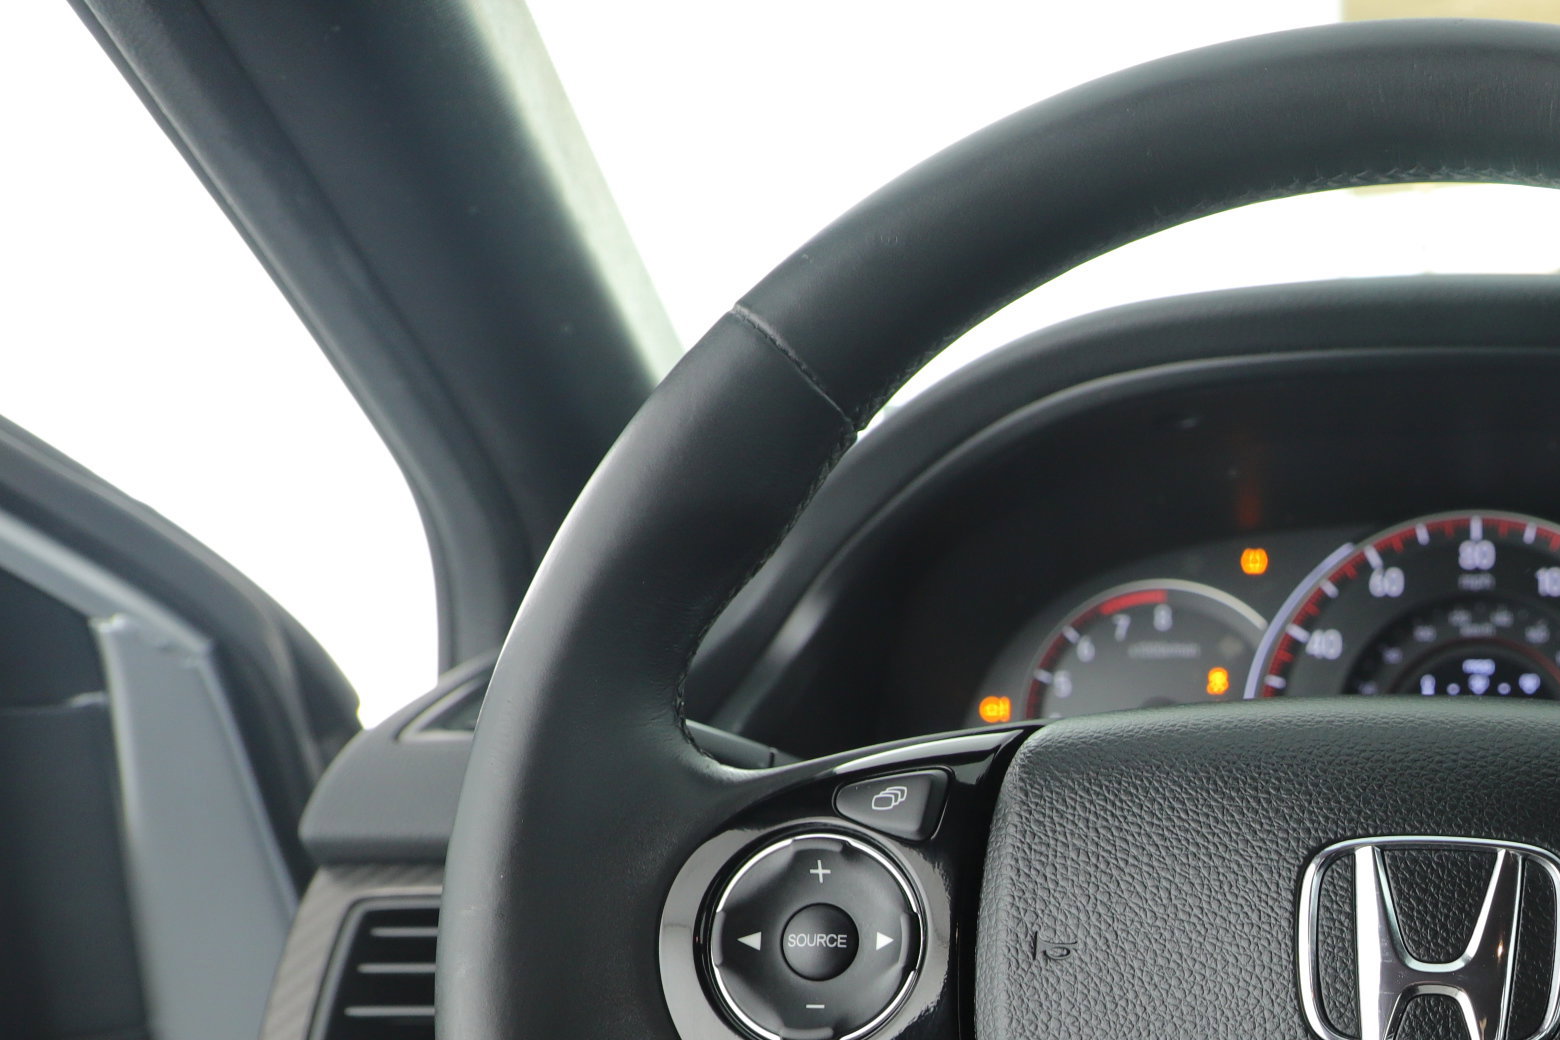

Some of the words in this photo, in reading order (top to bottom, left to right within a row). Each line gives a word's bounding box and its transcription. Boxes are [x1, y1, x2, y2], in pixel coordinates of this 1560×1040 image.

[1458, 541, 1496, 570] 80
[1369, 567, 1405, 597] 60
[1110, 613, 1132, 642] 7
[1153, 604, 1173, 632] 8
[1305, 629, 1343, 660] 40
[787, 933, 848, 949] SOURCE
